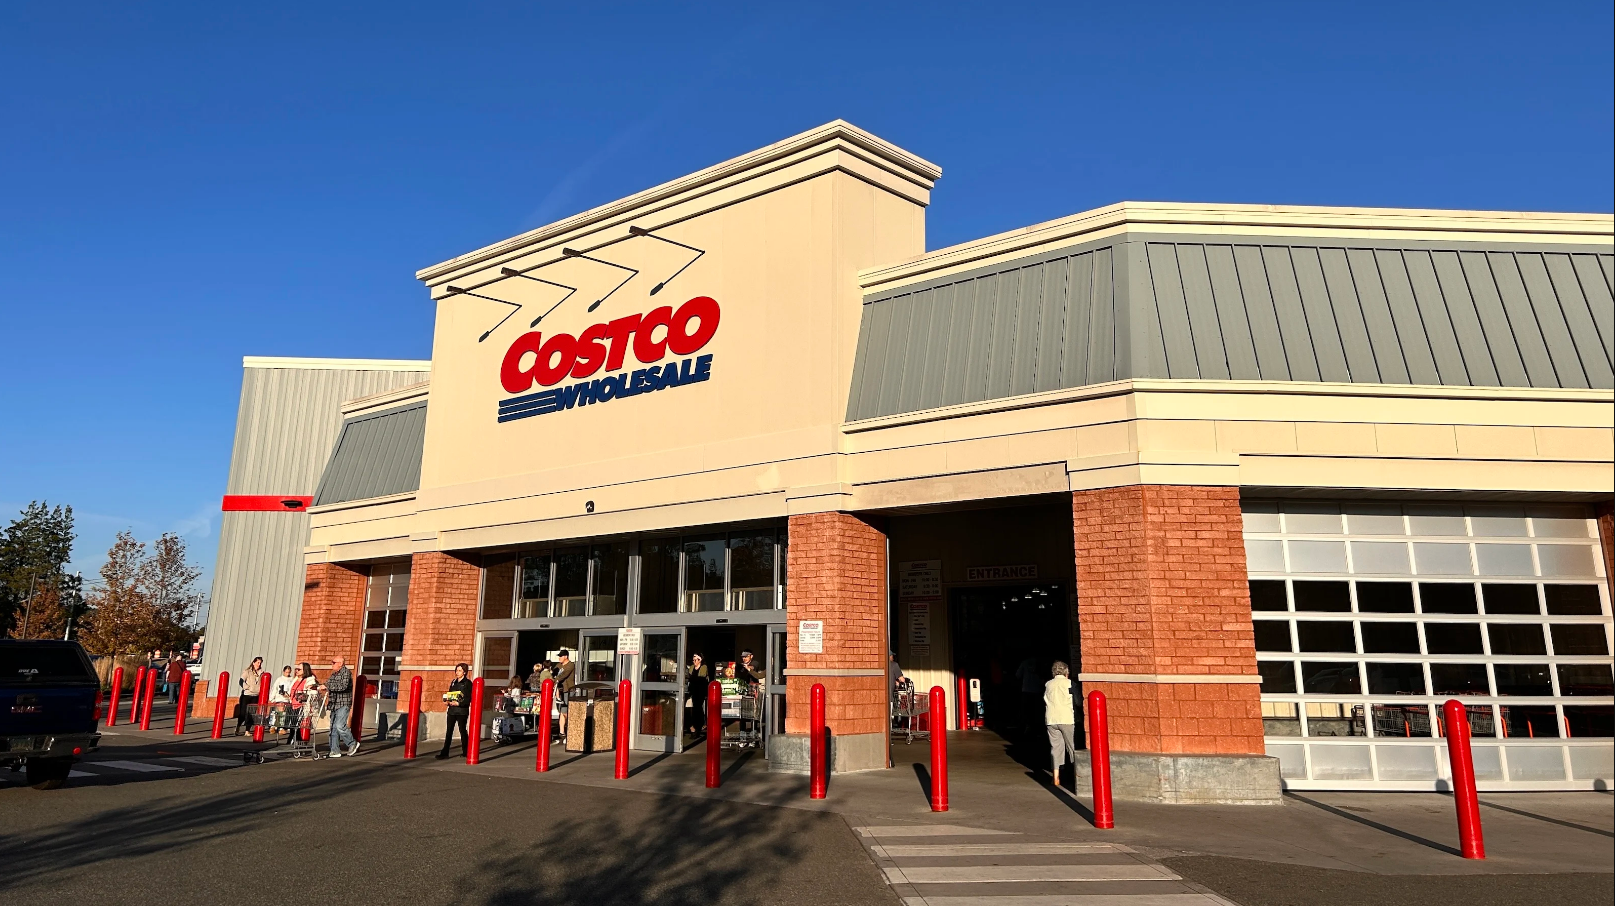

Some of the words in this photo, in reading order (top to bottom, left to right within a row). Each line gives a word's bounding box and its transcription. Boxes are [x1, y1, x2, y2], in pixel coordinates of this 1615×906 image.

[500, 296, 721, 394] COSTCO
[555, 354, 713, 411] WHOLESALE
[968, 566, 1036, 580] ENTRANCE
